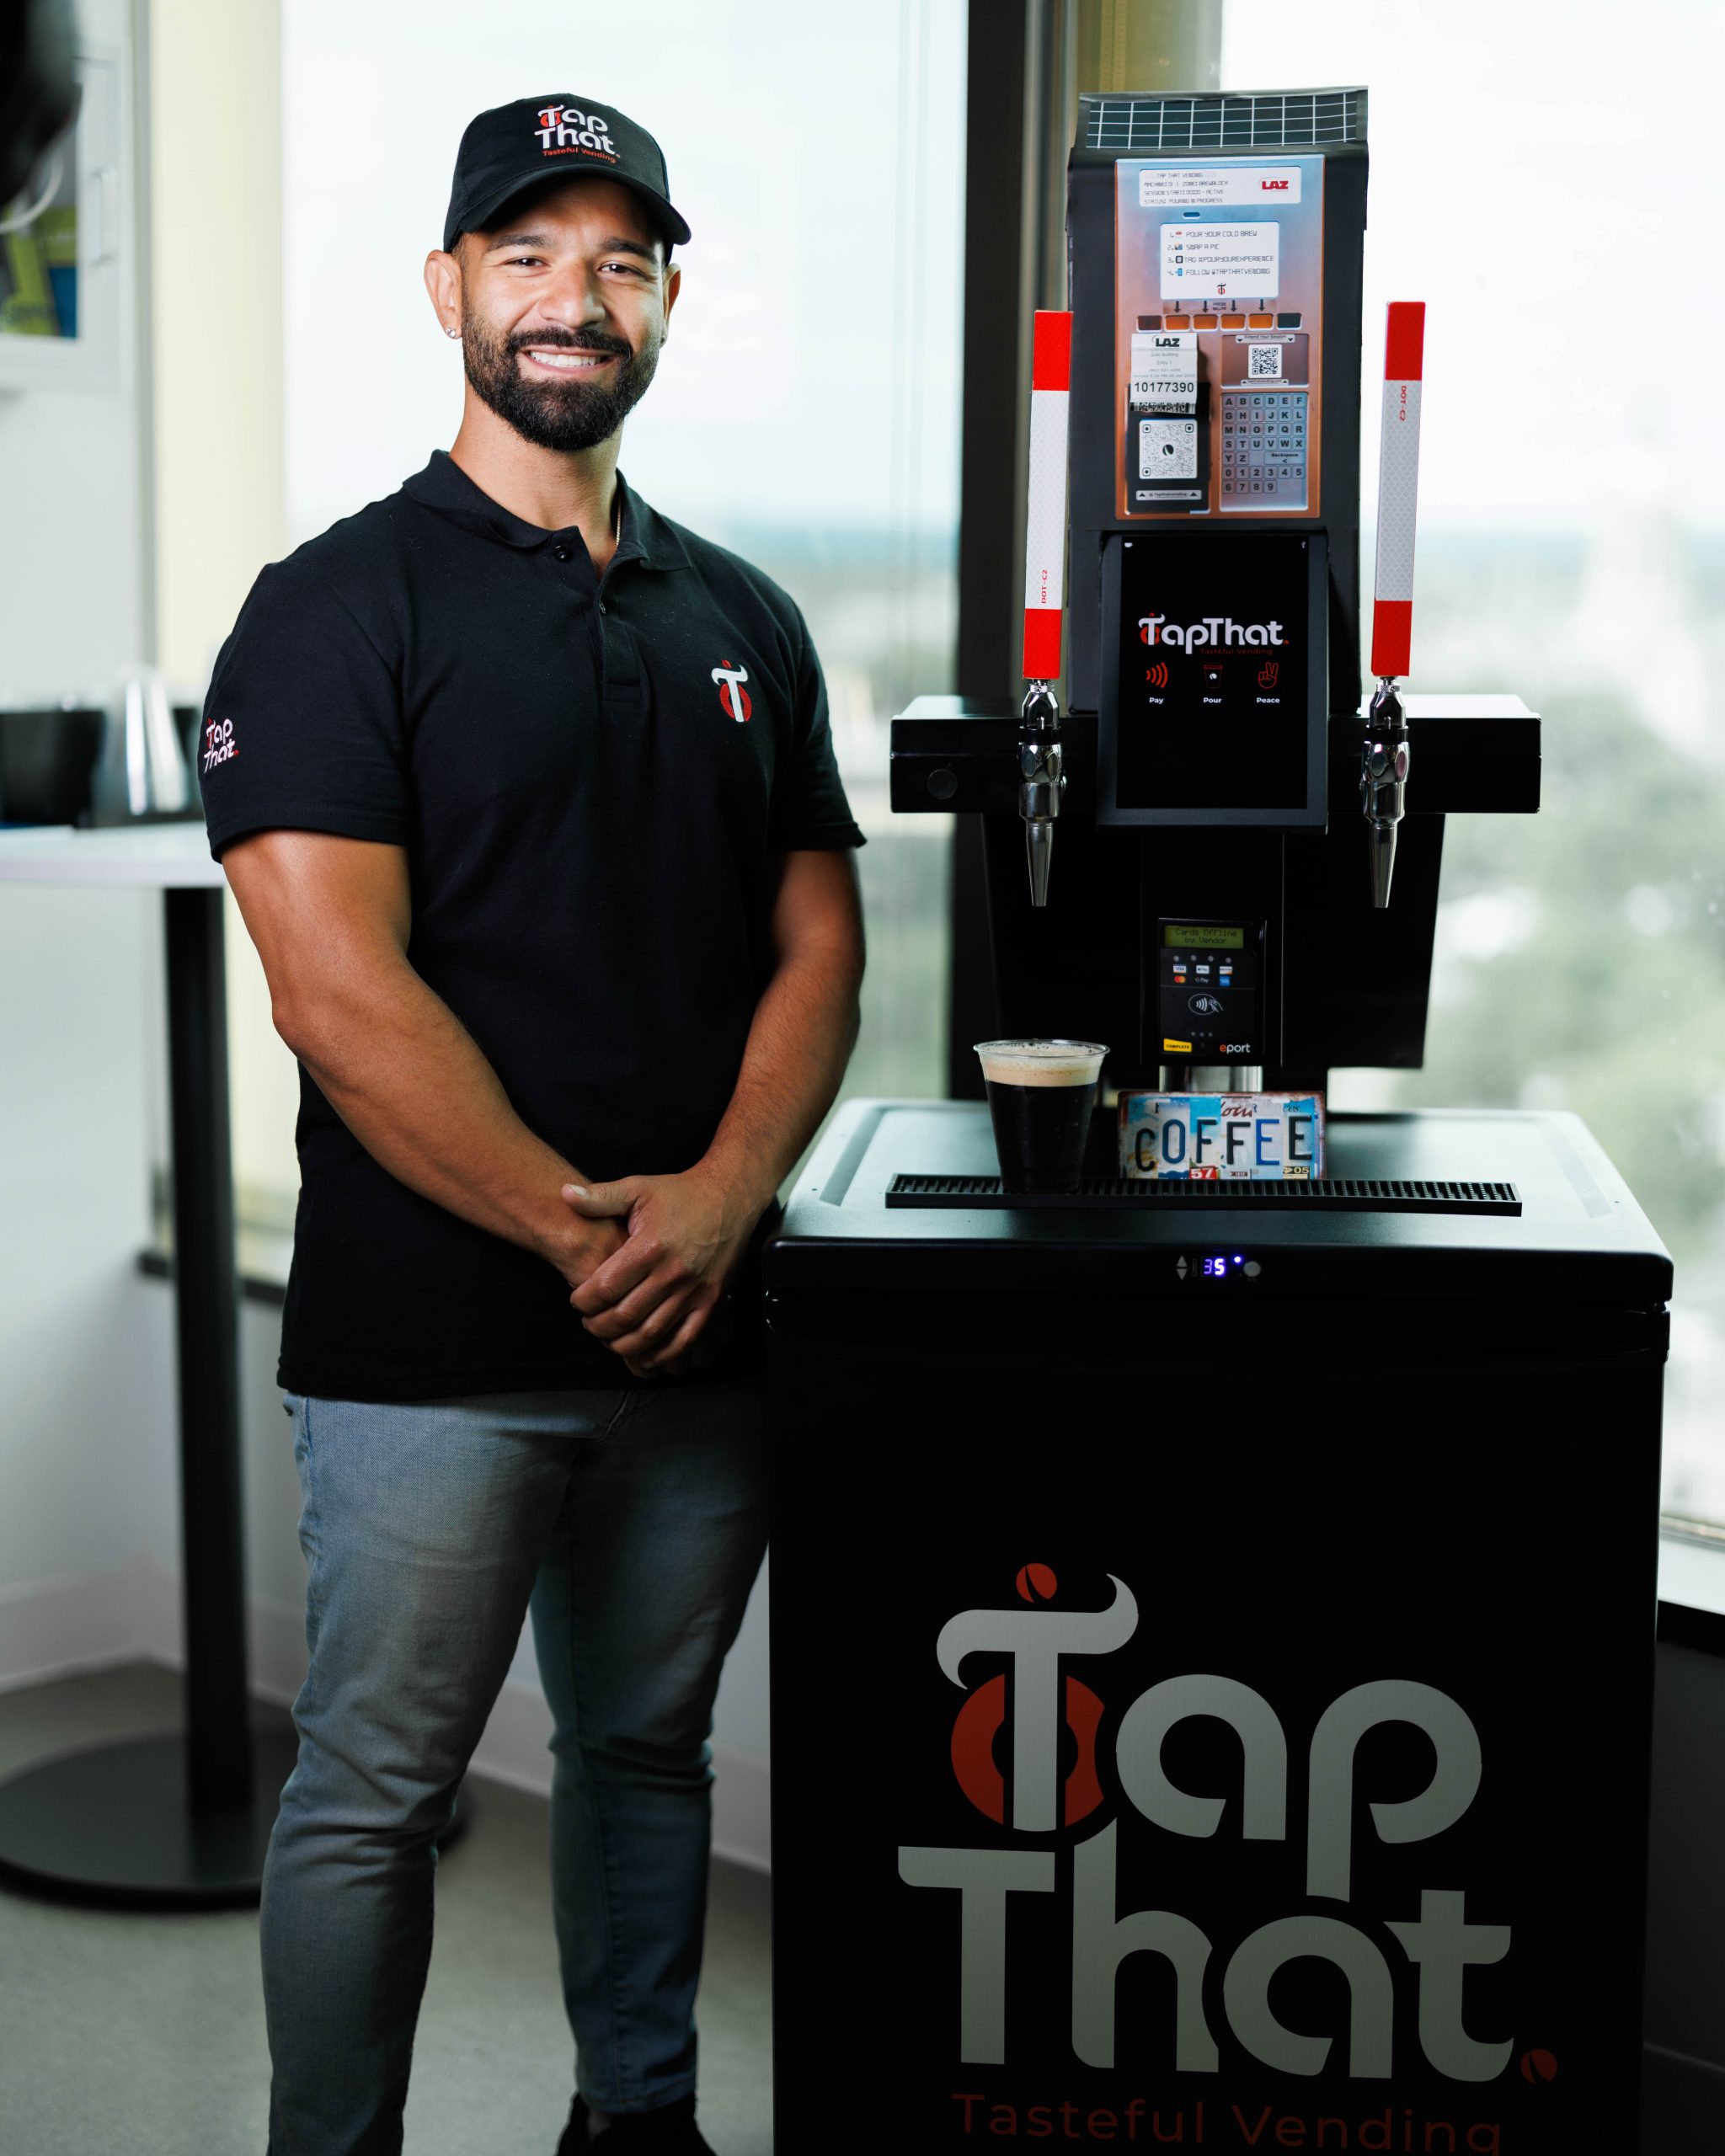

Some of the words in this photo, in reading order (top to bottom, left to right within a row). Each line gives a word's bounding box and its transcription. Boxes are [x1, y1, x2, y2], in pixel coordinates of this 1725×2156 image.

[538, 104, 608, 133] Tap
[542, 147, 579, 157] Tasteful
[580, 148, 617, 163] Vending
[1262, 180, 1289, 190] LAZ
[1156, 338, 1180, 347] LAZ
[1135, 382, 1194, 392] 10177390
[206, 718, 233, 750] Tap
[1204, 928, 1237, 937] Offline
[1199, 936, 1227, 944] Vendor
[1220, 1043, 1251, 1054] eport
[1135, 1114, 1312, 1172] COFFEE
[1190, 1168, 1214, 1179] 57
[1204, 1258, 1226, 1275] 35
[937, 1573, 1482, 1903] Tap
[952, 2094, 1204, 2143] Tasteful
[1232, 2105, 1501, 2156] Vending
